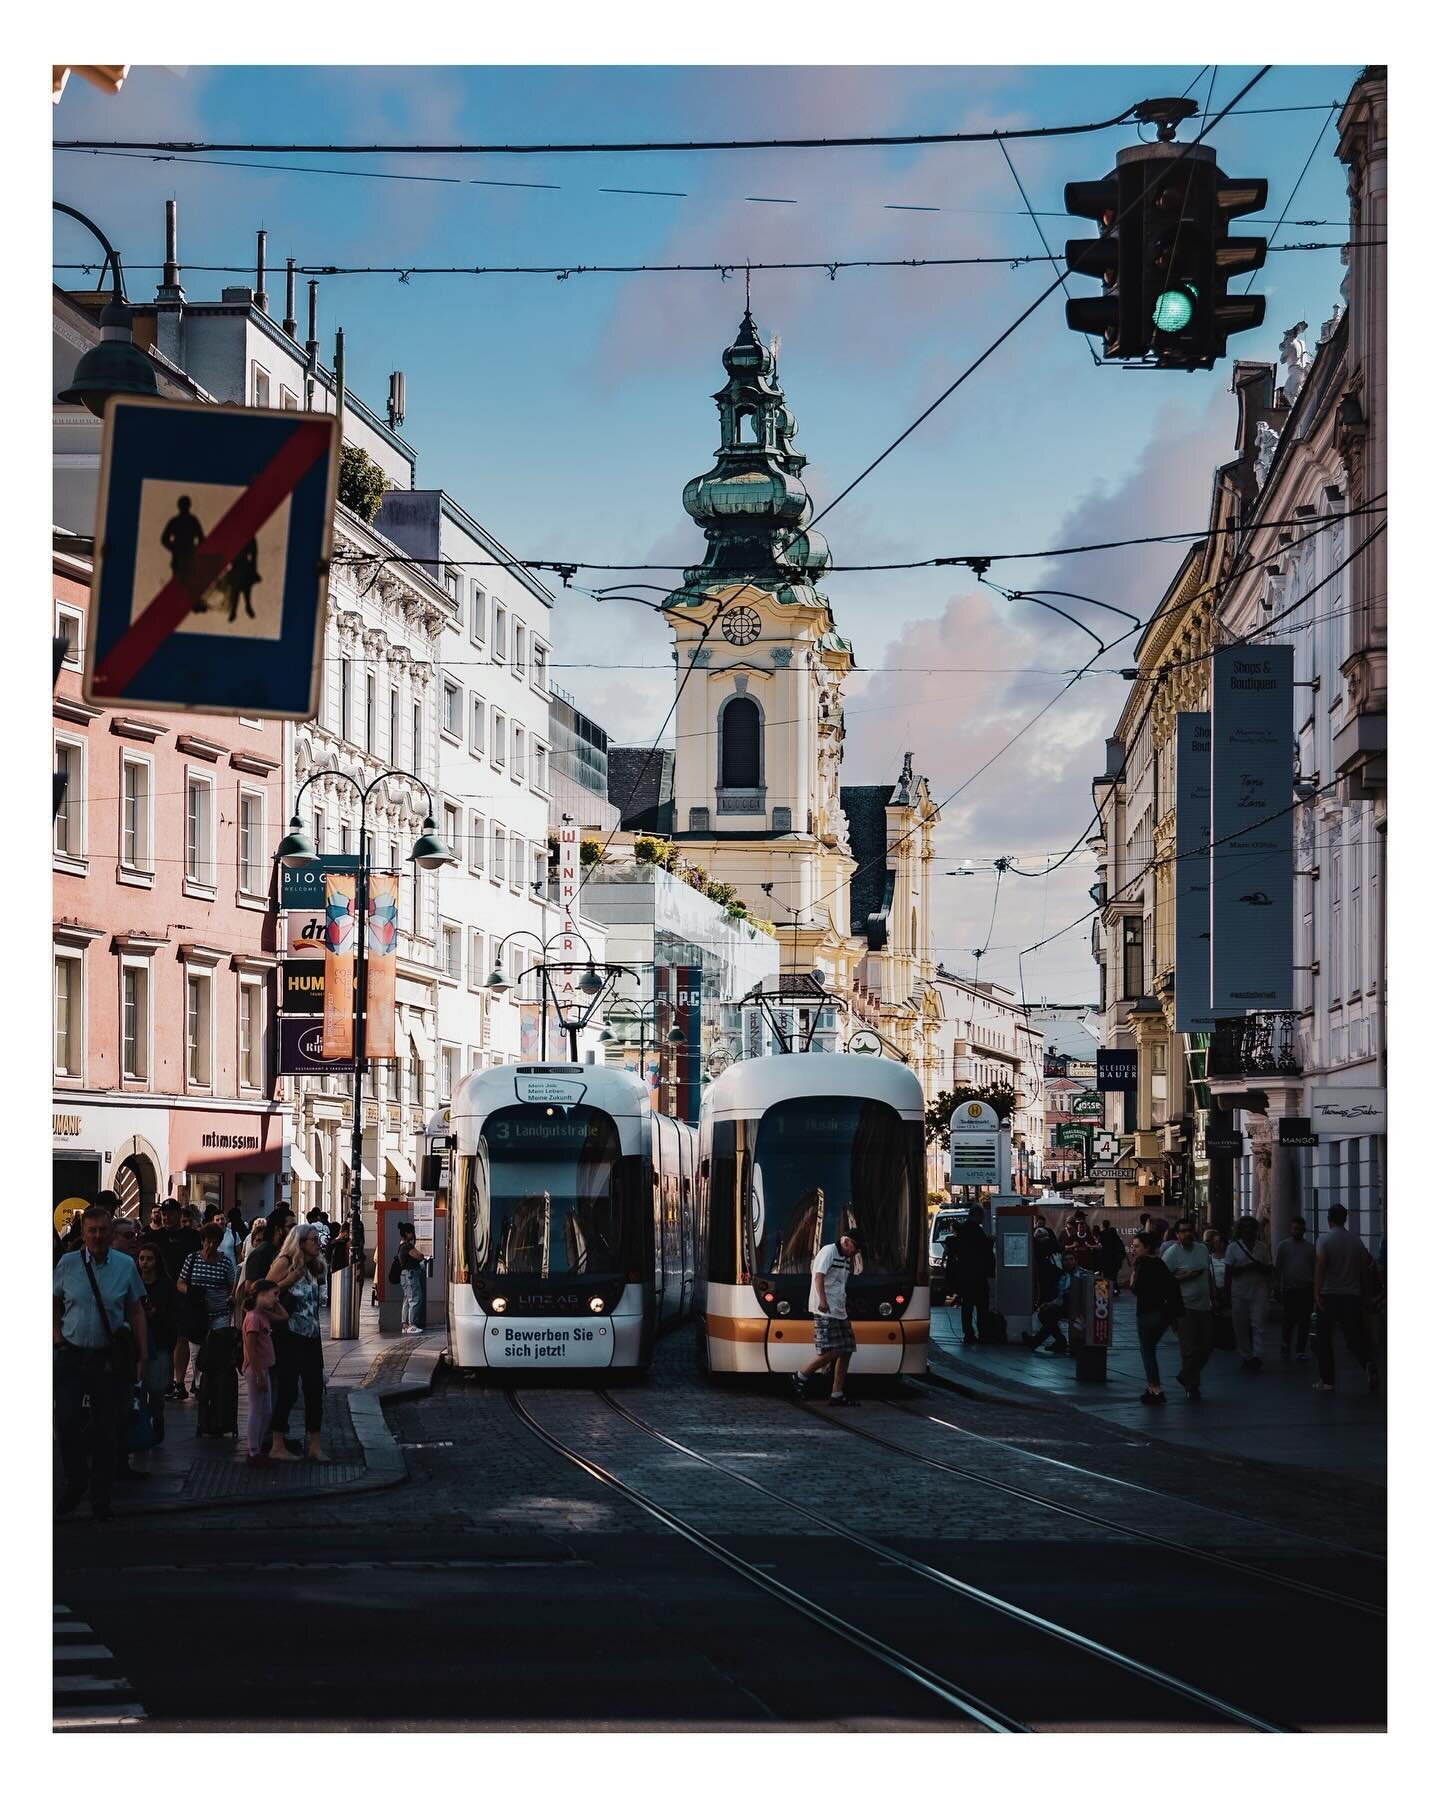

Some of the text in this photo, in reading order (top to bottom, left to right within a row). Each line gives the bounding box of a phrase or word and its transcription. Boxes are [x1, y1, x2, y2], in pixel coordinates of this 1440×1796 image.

[1233, 661, 1272, 676] Shops &
[1231, 676, 1277, 692] Boutiquen
[1314, 1104, 1383, 1118] Thomas Sabo
[496, 1122, 510, 1139] 3
[202, 1131, 259, 1149] intimissimi
[1091, 1169, 1133, 1177] APOTHEKE
[505, 1328, 593, 1341] Bewerben Sie
[505, 1344, 566, 1359] sich jetzt!
